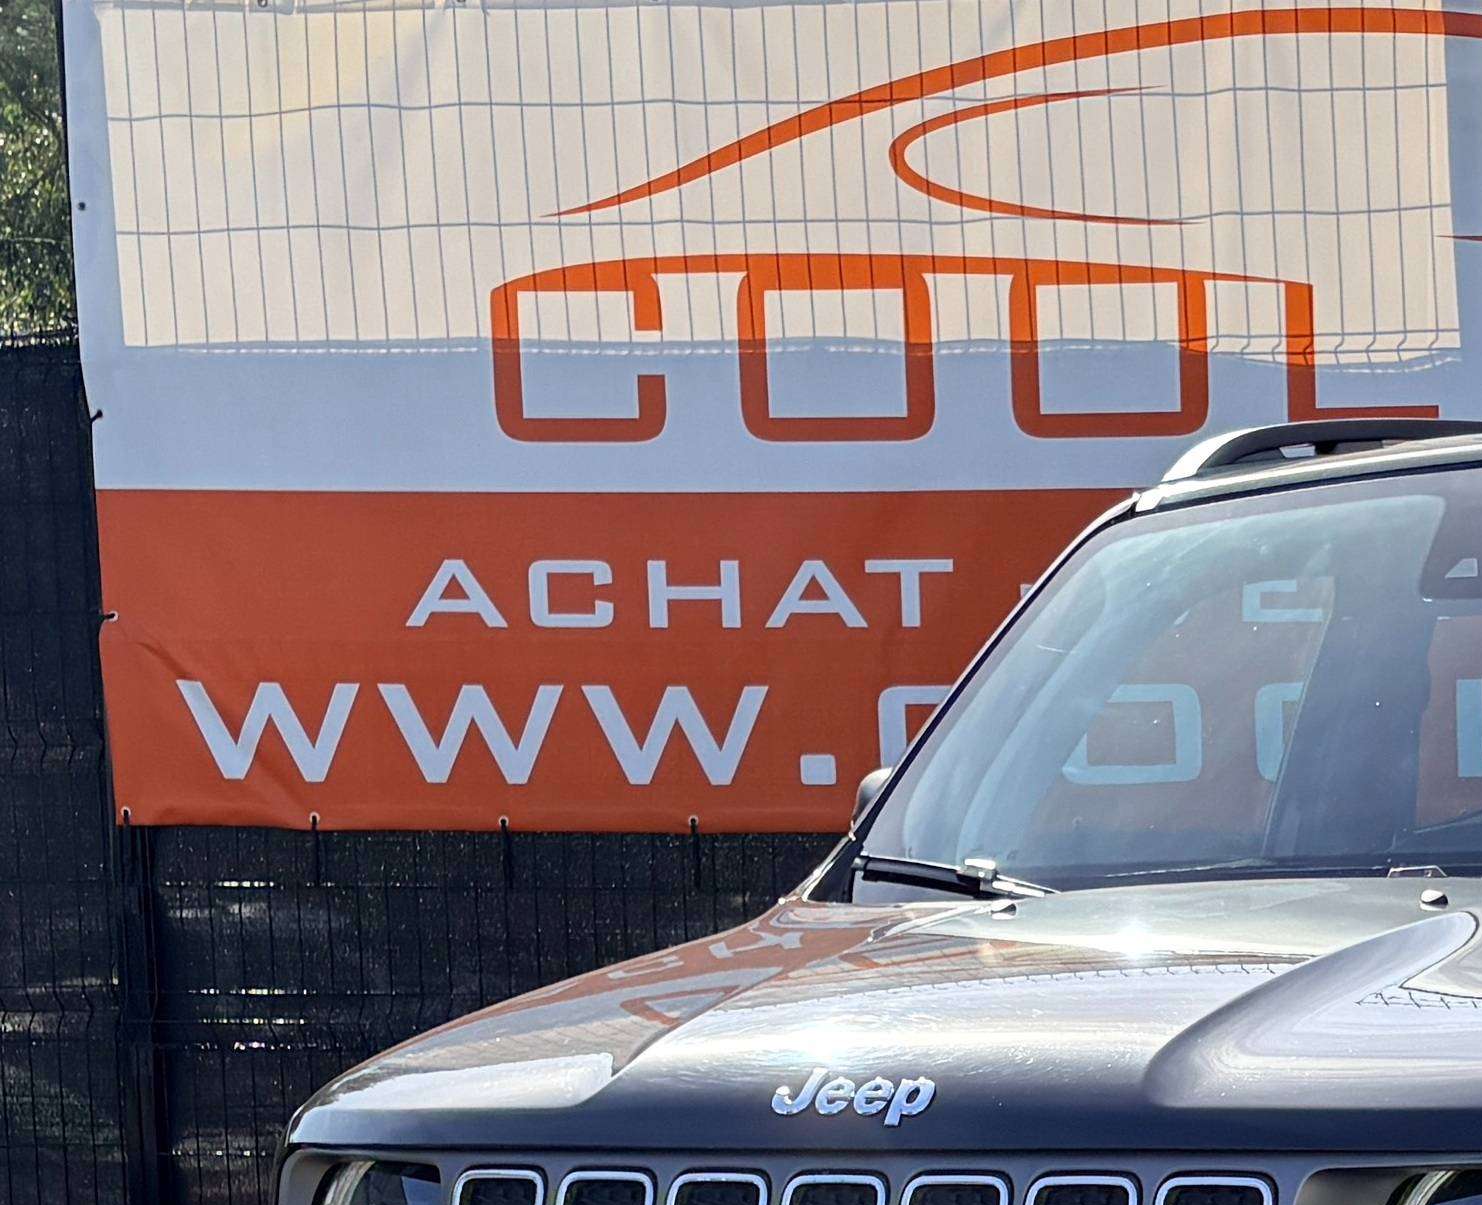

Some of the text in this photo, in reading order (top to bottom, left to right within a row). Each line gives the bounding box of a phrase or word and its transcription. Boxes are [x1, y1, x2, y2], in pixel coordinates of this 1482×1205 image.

[490, 253, 1439, 442] COOL
[405, 558, 954, 629] ACHAT
[771, 1067, 936, 1127] Jeep
